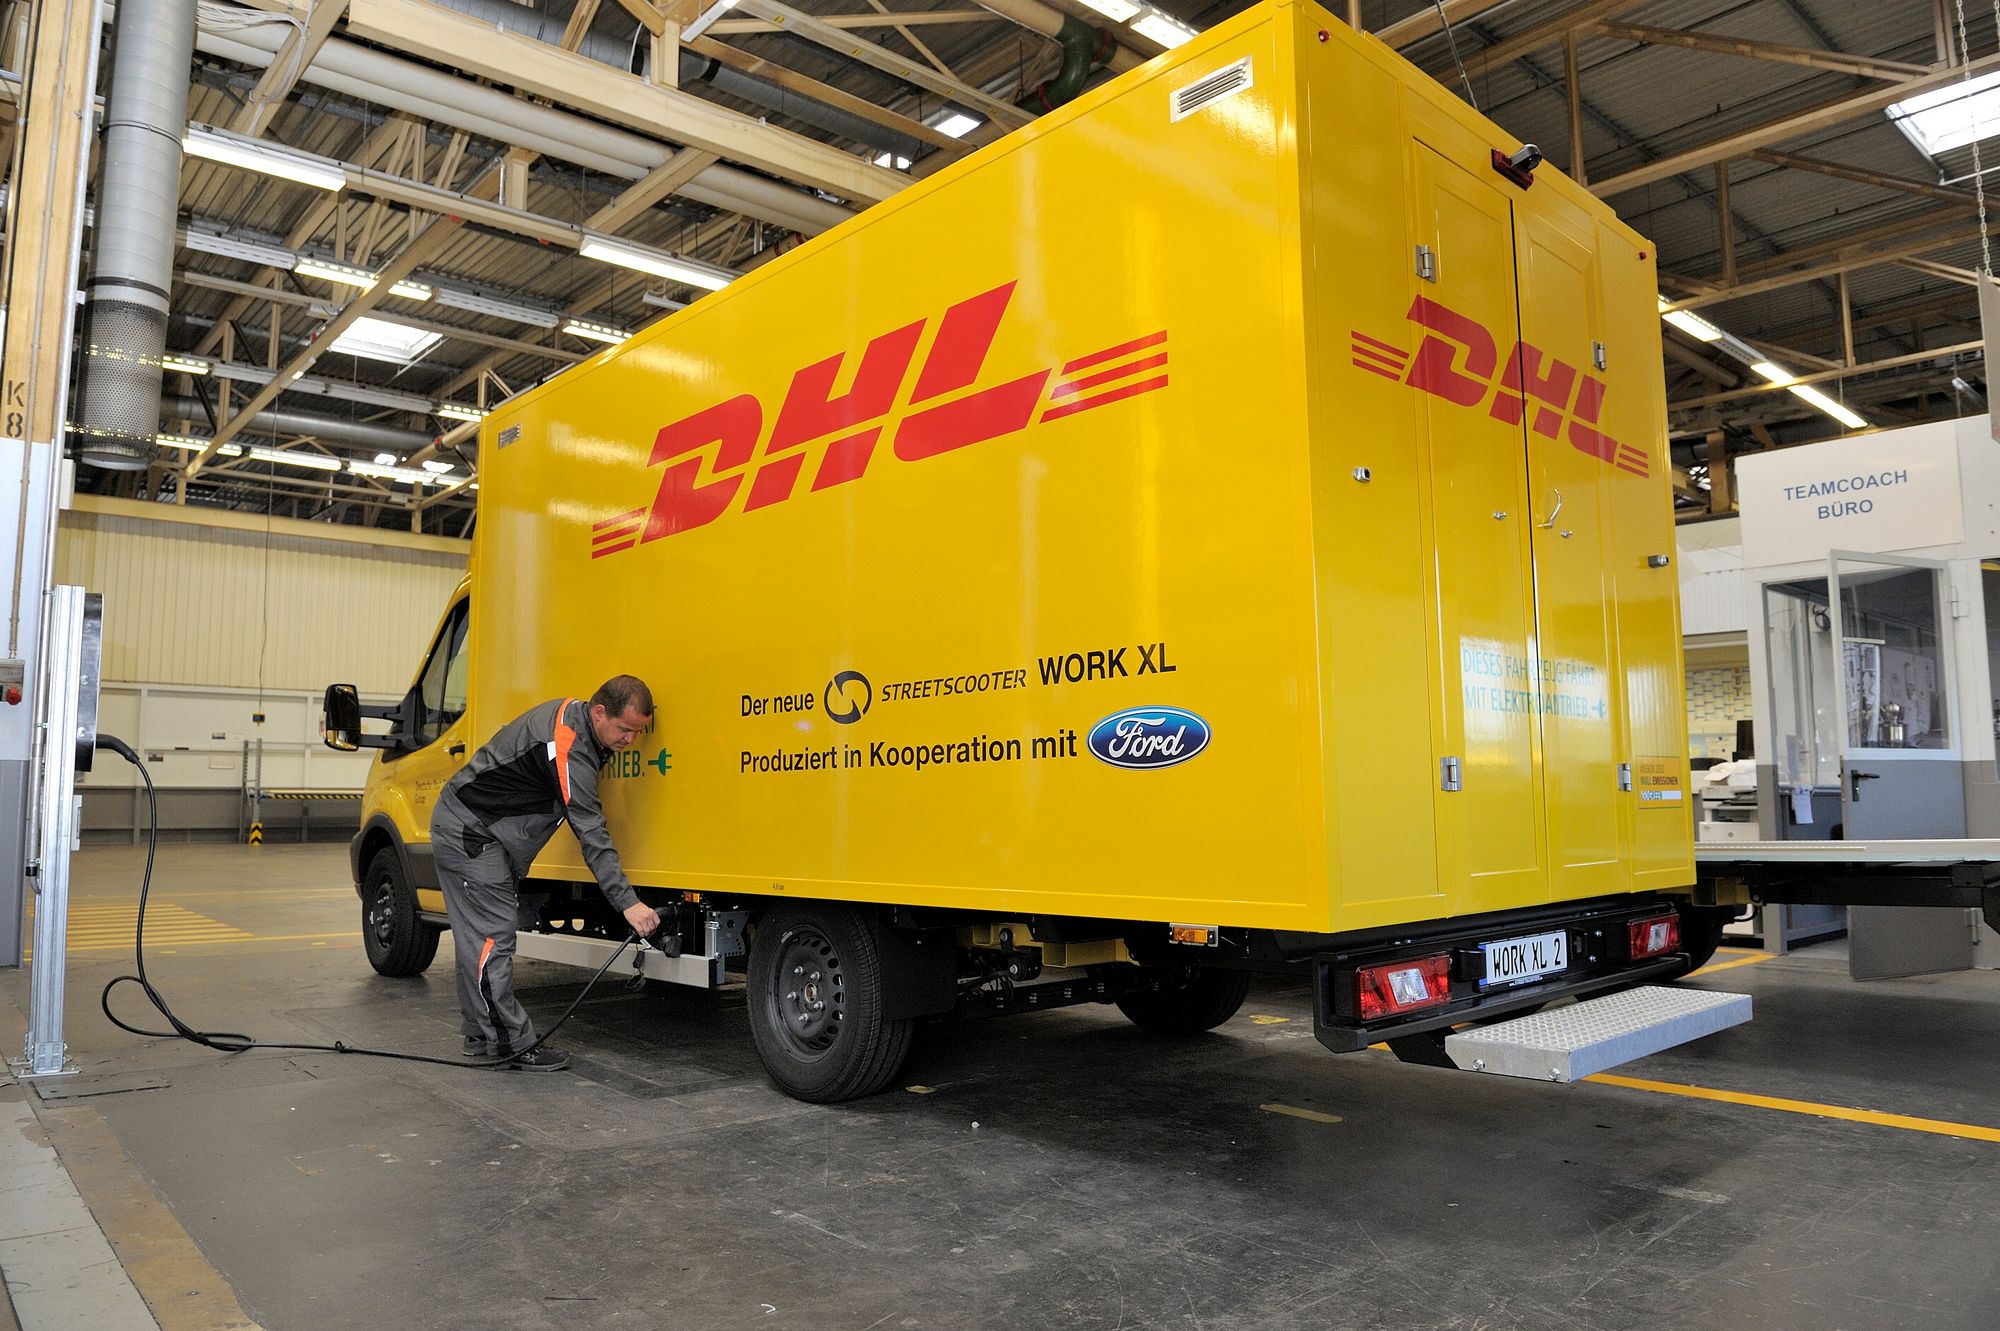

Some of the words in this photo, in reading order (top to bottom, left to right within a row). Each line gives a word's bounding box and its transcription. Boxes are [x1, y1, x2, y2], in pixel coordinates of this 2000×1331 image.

[7, 380, 25, 407] K
[1405, 294, 1618, 465] DHL
[6, 412, 23, 438] 8
[640, 279, 1052, 546] DHL
[1784, 469, 1908, 500] TEAMCOACH
[1818, 499, 1873, 519] BÜRO
[741, 694, 769, 717] Der
[773, 692, 815, 714] neue
[881, 668, 1027, 702] STREETSCOOTER
[1038, 647, 1129, 686] WORK
[1137, 642, 1177, 675] XL
[1463, 649, 1502, 677] DIESES
[1465, 685, 1487, 709] MIT
[740, 747, 837, 773] Produziert
[844, 744, 862, 768] in
[870, 735, 1022, 771] Kooperation
[1032, 729, 1077, 759] mit
[1108, 716, 1187, 759] Ford
[1493, 944, 1527, 978] WORK
[1532, 941, 1547, 971] XL
[1554, 938, 1561, 966] 2
